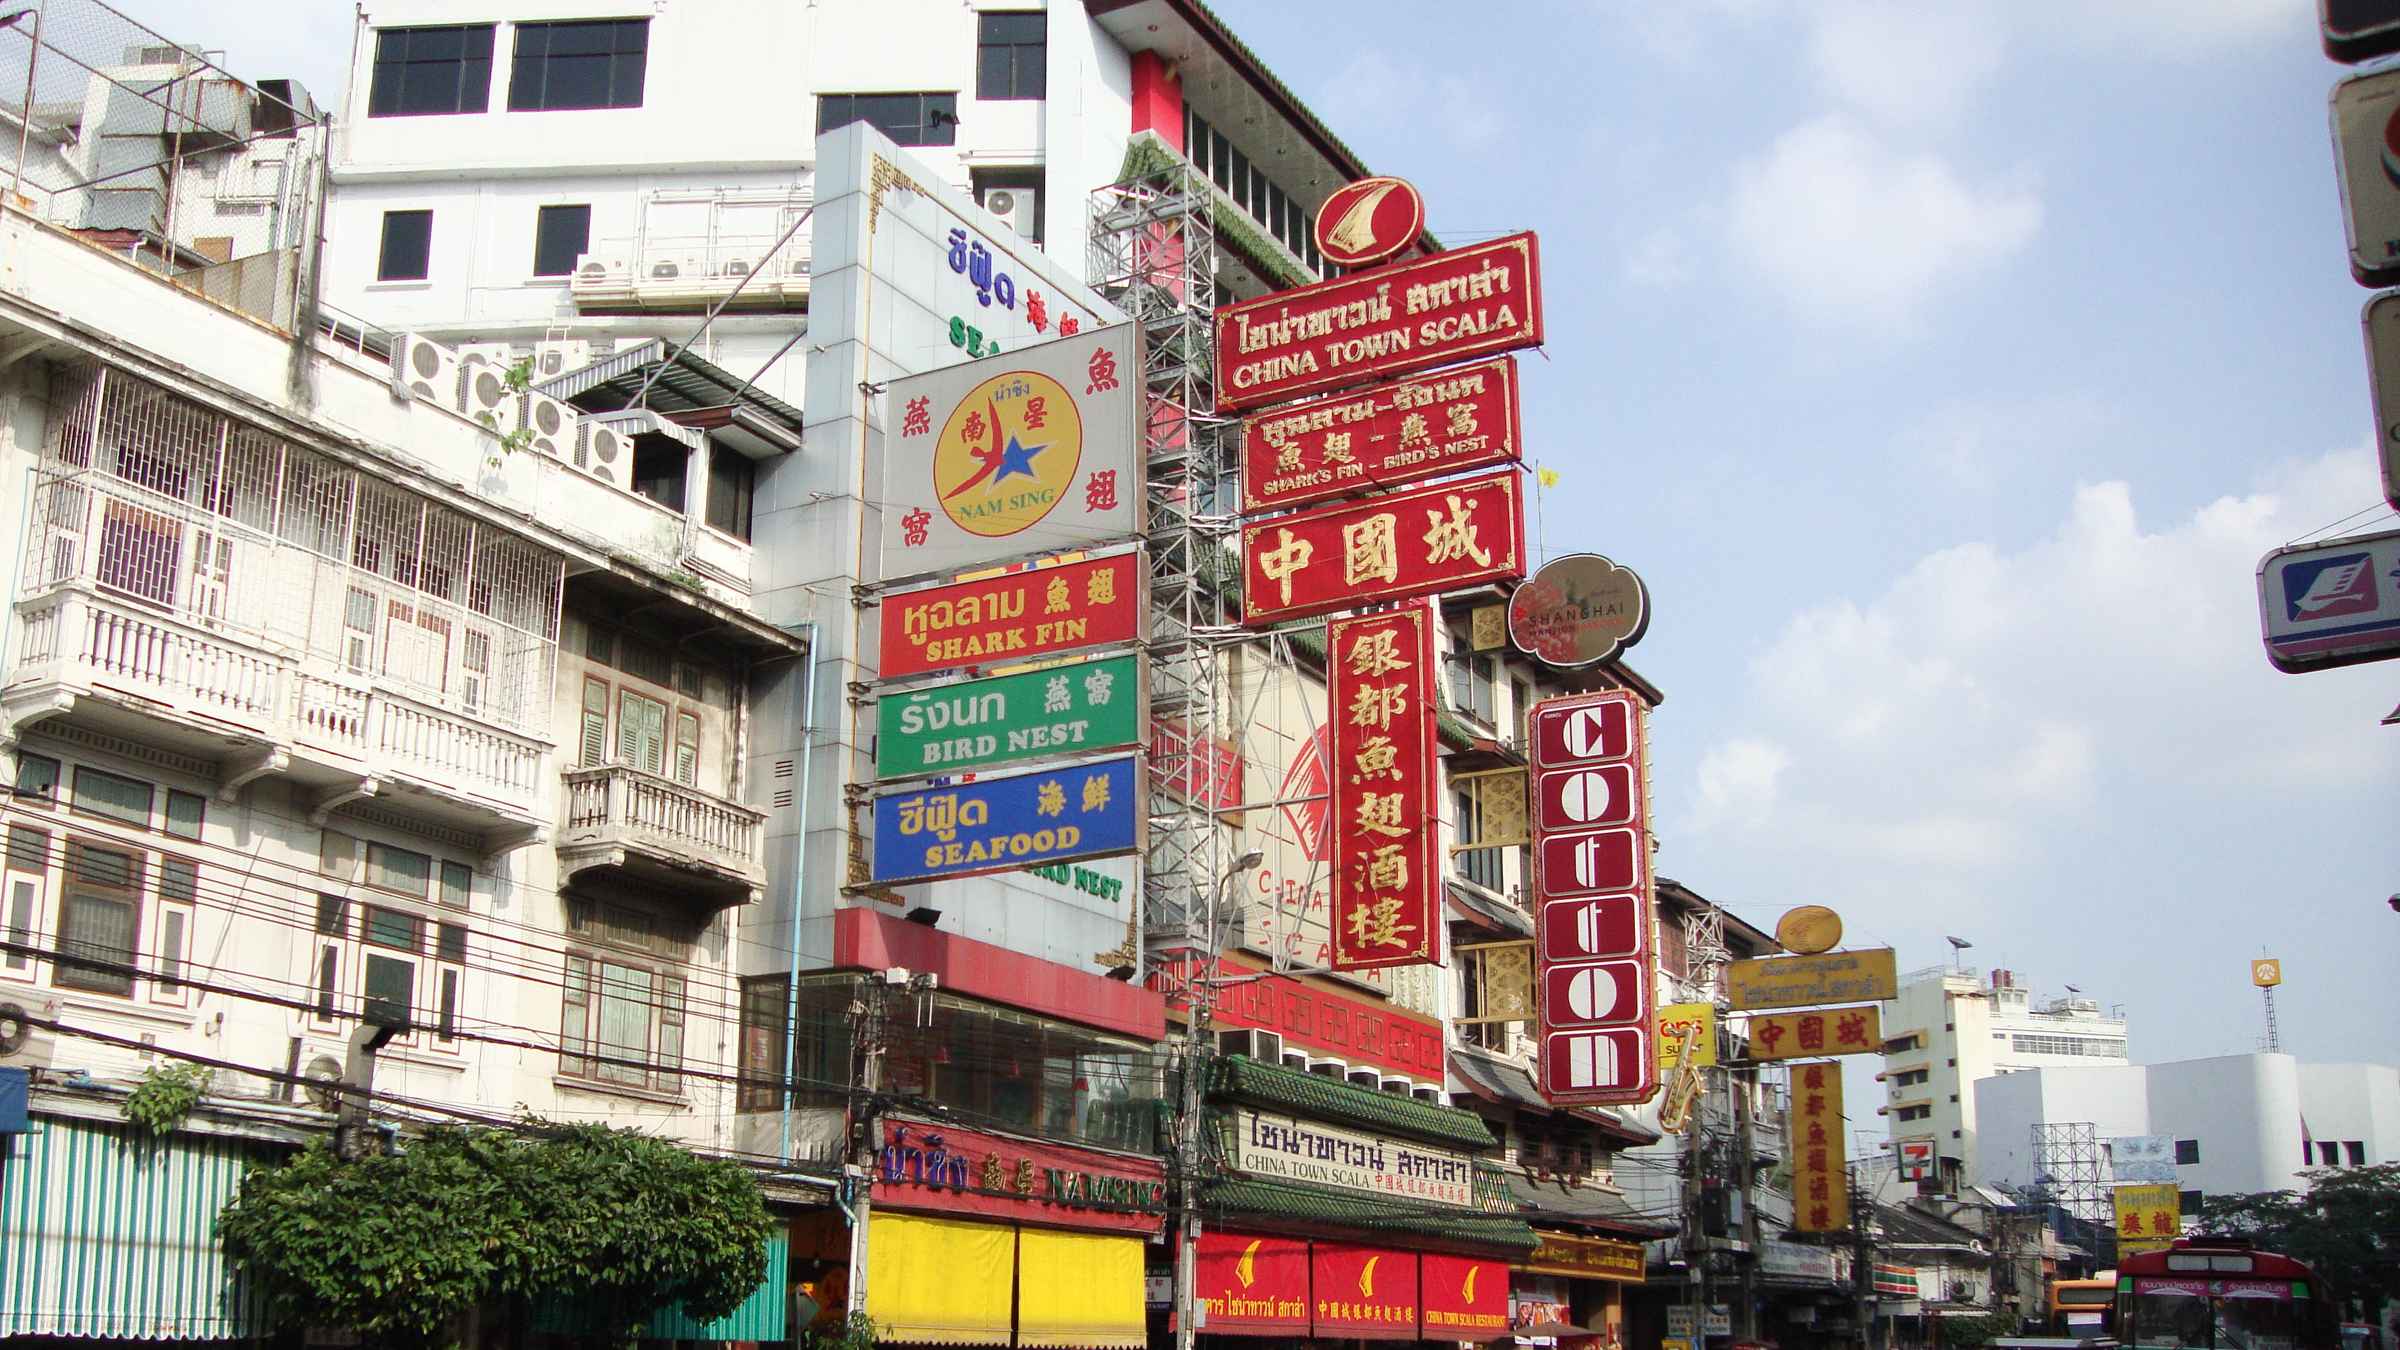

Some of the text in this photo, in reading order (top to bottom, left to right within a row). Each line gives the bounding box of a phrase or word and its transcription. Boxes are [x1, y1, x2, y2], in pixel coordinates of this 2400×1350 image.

[1235, 258, 1512, 355] ไชน่าทาวน์ สกาล่า
[1233, 304, 1518, 388] CHINA TOWN SCALA
[1263, 469, 1332, 496] SHARK'S
[1337, 463, 1364, 480] FIN
[1383, 447, 1441, 469] BIRD'S
[1445, 435, 1489, 456] NEST
[959, 487, 1056, 521] NAM SING
[1260, 495, 1491, 606] 中國城
[904, 568, 1116, 645] หูฉลาม 魚翅
[1529, 602, 1624, 627] SHANGHAI
[926, 619, 1088, 662] SHARK FIN
[900, 669, 1114, 735] รังนก 燕窩
[923, 720, 1089, 765] BIRD NEST
[1037, 774, 1111, 818] 海鮮
[1345, 629, 1416, 949] 銀都魚翅酒樓
[925, 826, 1081, 869] SEAFOOD
[1074, 866, 1123, 903] NEST
[1252, 1112, 1385, 1172] ไชน่าทาวน์
[1246, 1153, 1287, 1175] CHINA
[1291, 1161, 1328, 1181] TOWN
[1331, 1168, 1370, 1190] SCALA
[1426, 1311, 1443, 1325] CHINA
[1443, 1312, 1459, 1326] TOWN
